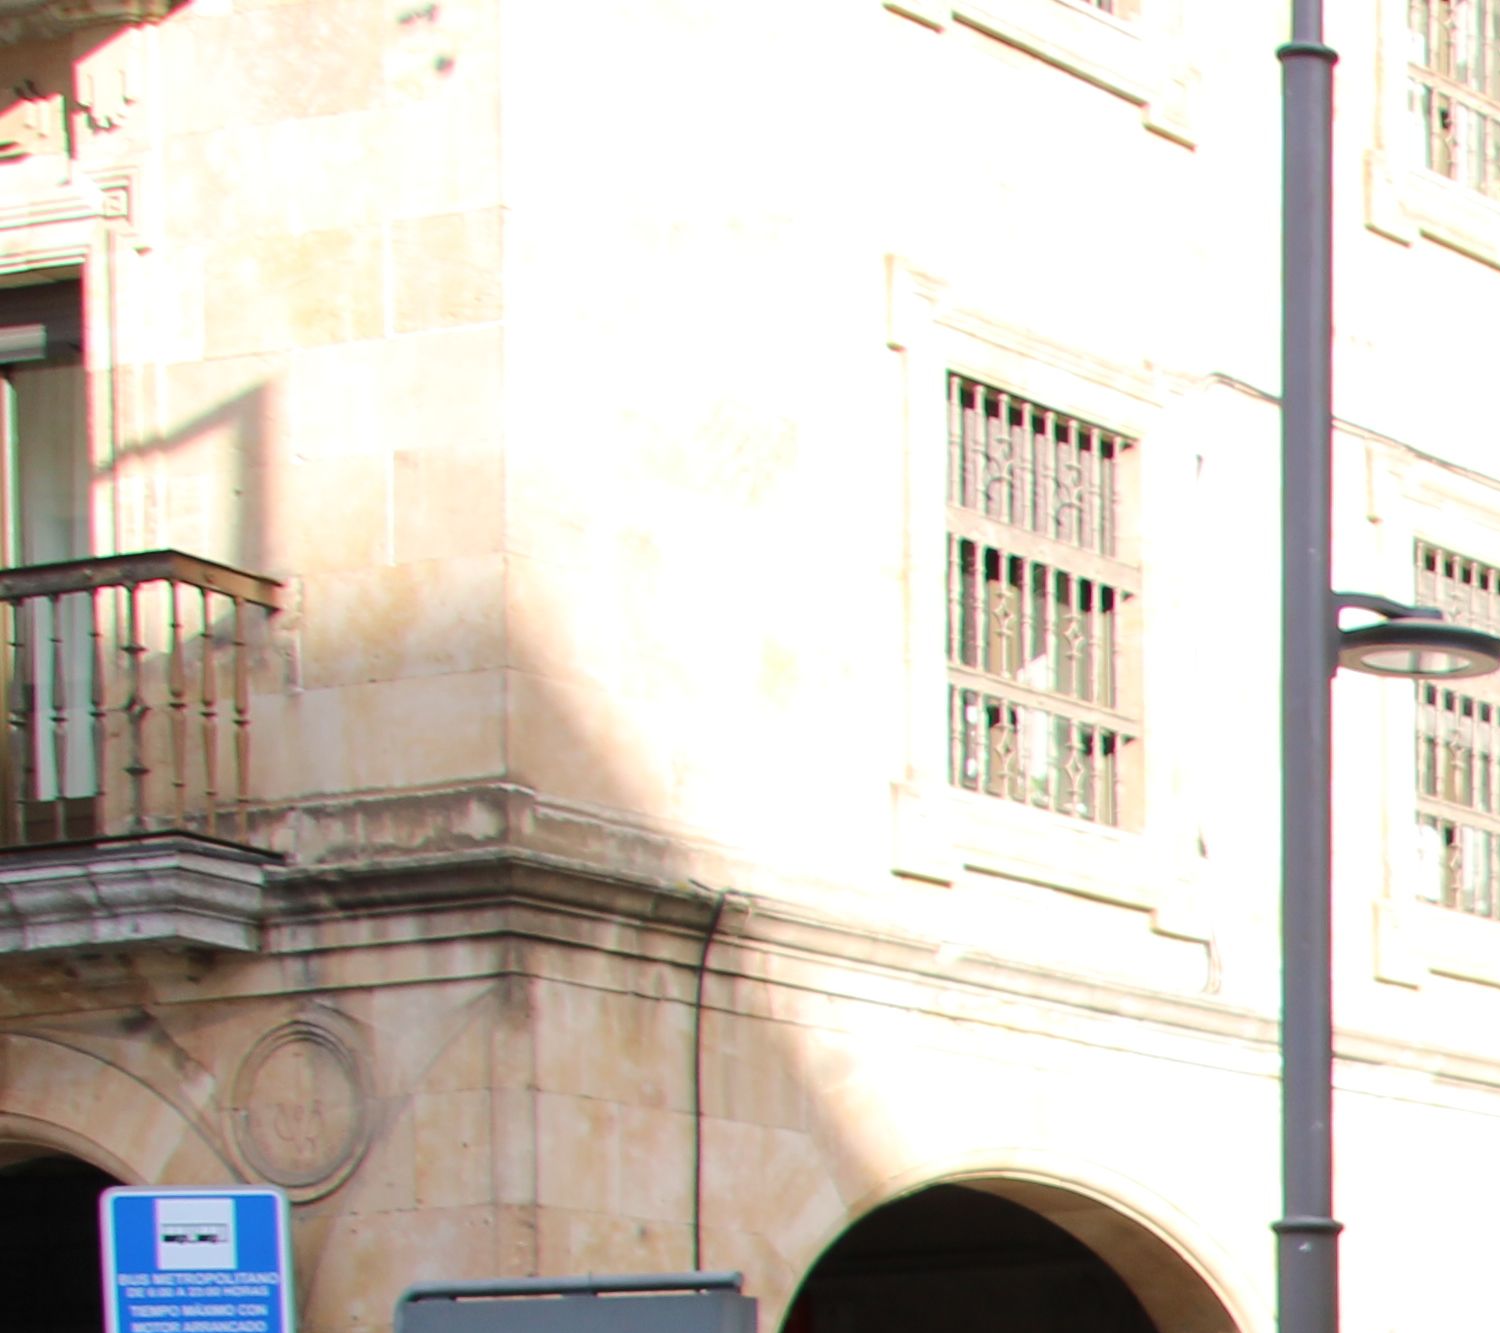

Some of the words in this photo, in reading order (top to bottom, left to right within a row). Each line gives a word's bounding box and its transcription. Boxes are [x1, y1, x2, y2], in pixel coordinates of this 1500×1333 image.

[118, 1272, 149, 1286] BUS
[152, 1272, 280, 1286] METROPOLITANO
[129, 1304, 180, 1317] TIEMPO
[237, 1303, 269, 1316] CON
[183, 1320, 268, 1333] ARRANCADO
